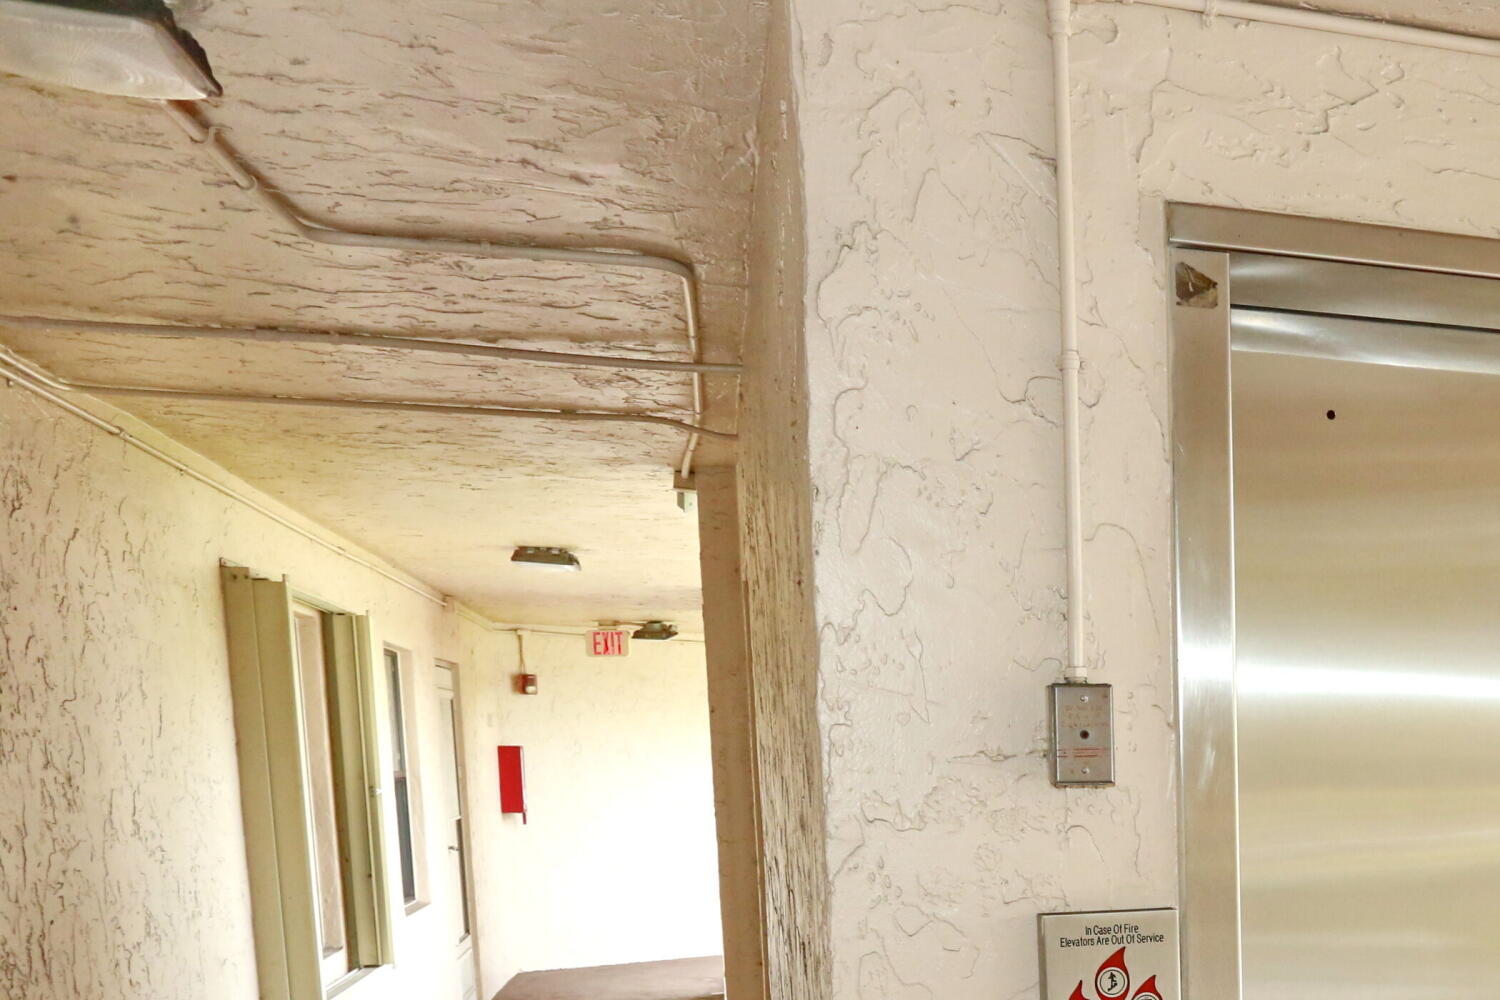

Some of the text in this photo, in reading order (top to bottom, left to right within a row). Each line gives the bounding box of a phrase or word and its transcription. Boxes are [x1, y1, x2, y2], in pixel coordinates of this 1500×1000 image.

[592, 631, 623, 655] EXIT
[1085, 926, 1092, 935] In
[1093, 925, 1112, 935] Case
[1123, 923, 1139, 933] Fire
[1060, 936, 1095, 947] Elevators
[1096, 935, 1110, 945] Are
[1111, 934, 1125, 945] Out
[1136, 932, 1164, 943] Service
